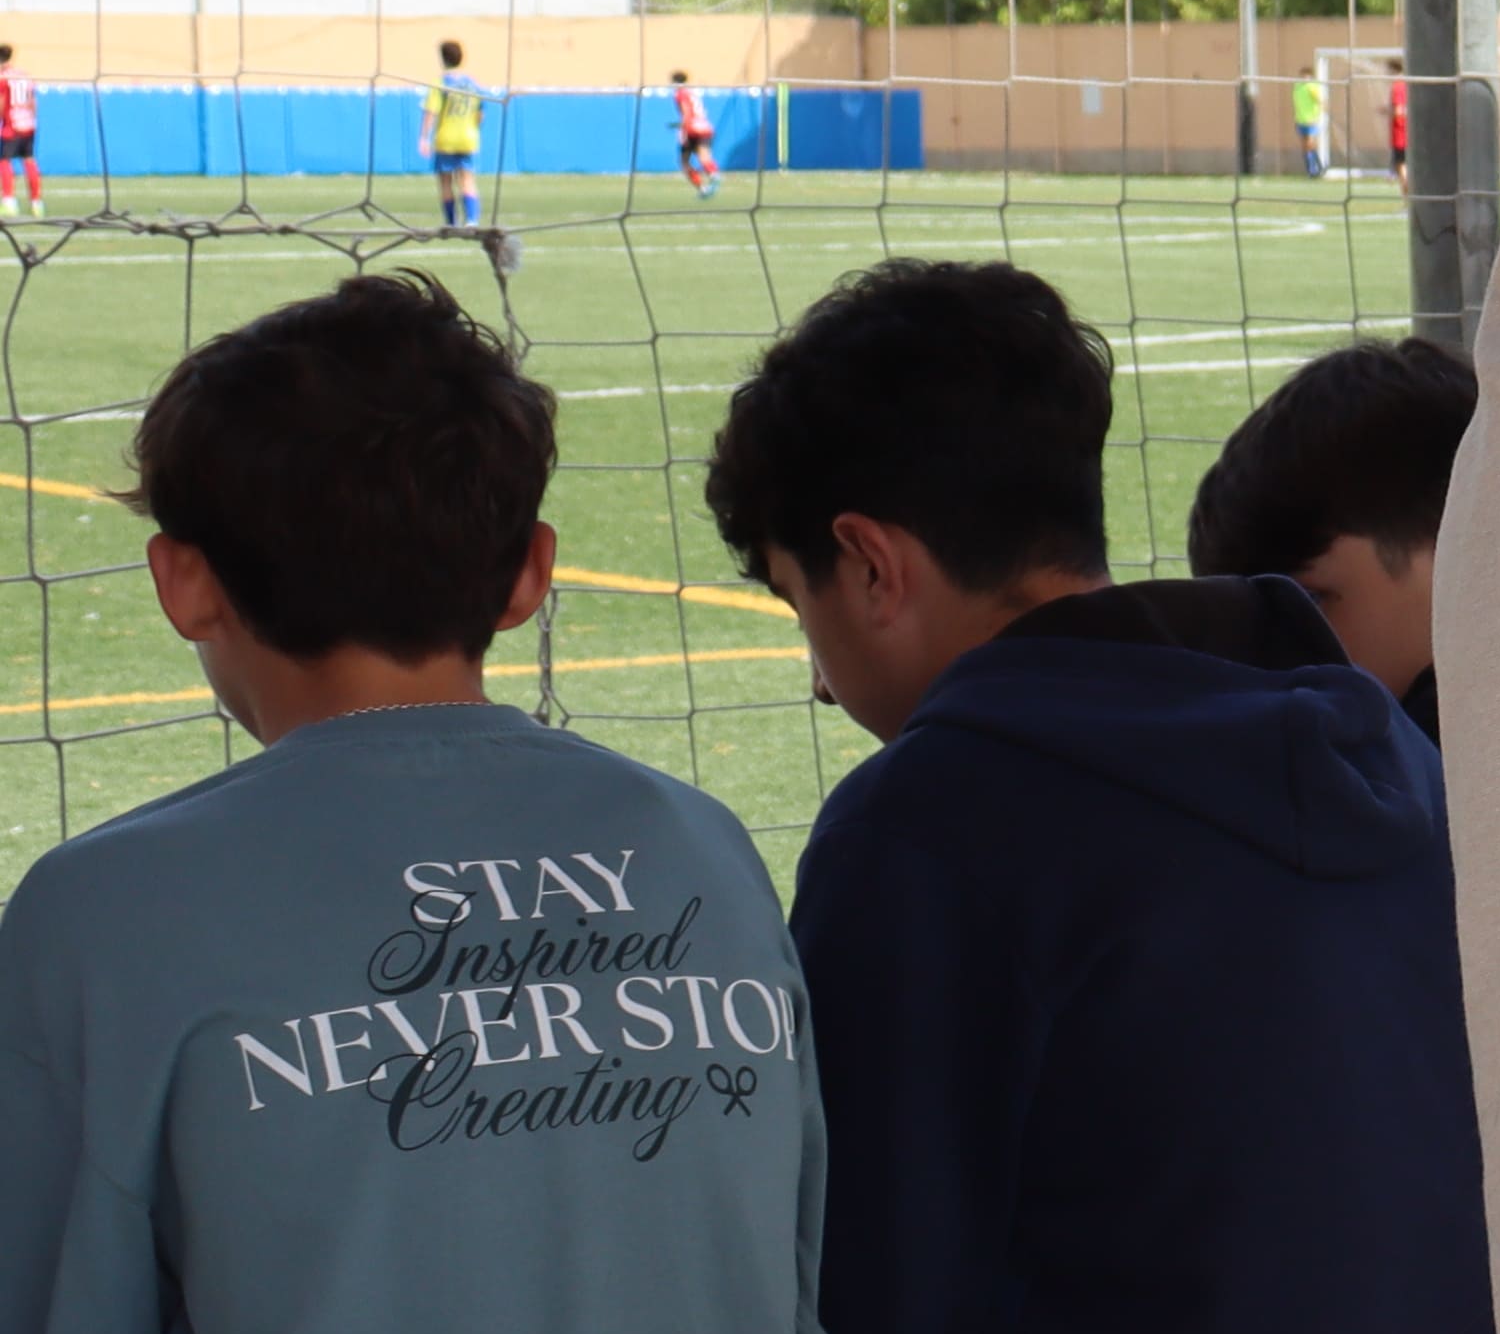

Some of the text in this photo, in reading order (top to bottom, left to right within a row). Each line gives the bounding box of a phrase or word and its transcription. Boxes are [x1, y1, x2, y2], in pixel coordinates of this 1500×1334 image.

[403, 850, 635, 925] STAY
[367, 890, 702, 1021] Inspired
[233, 976, 796, 1112] NEVER STOP
[366, 1029, 702, 1163] Creating
